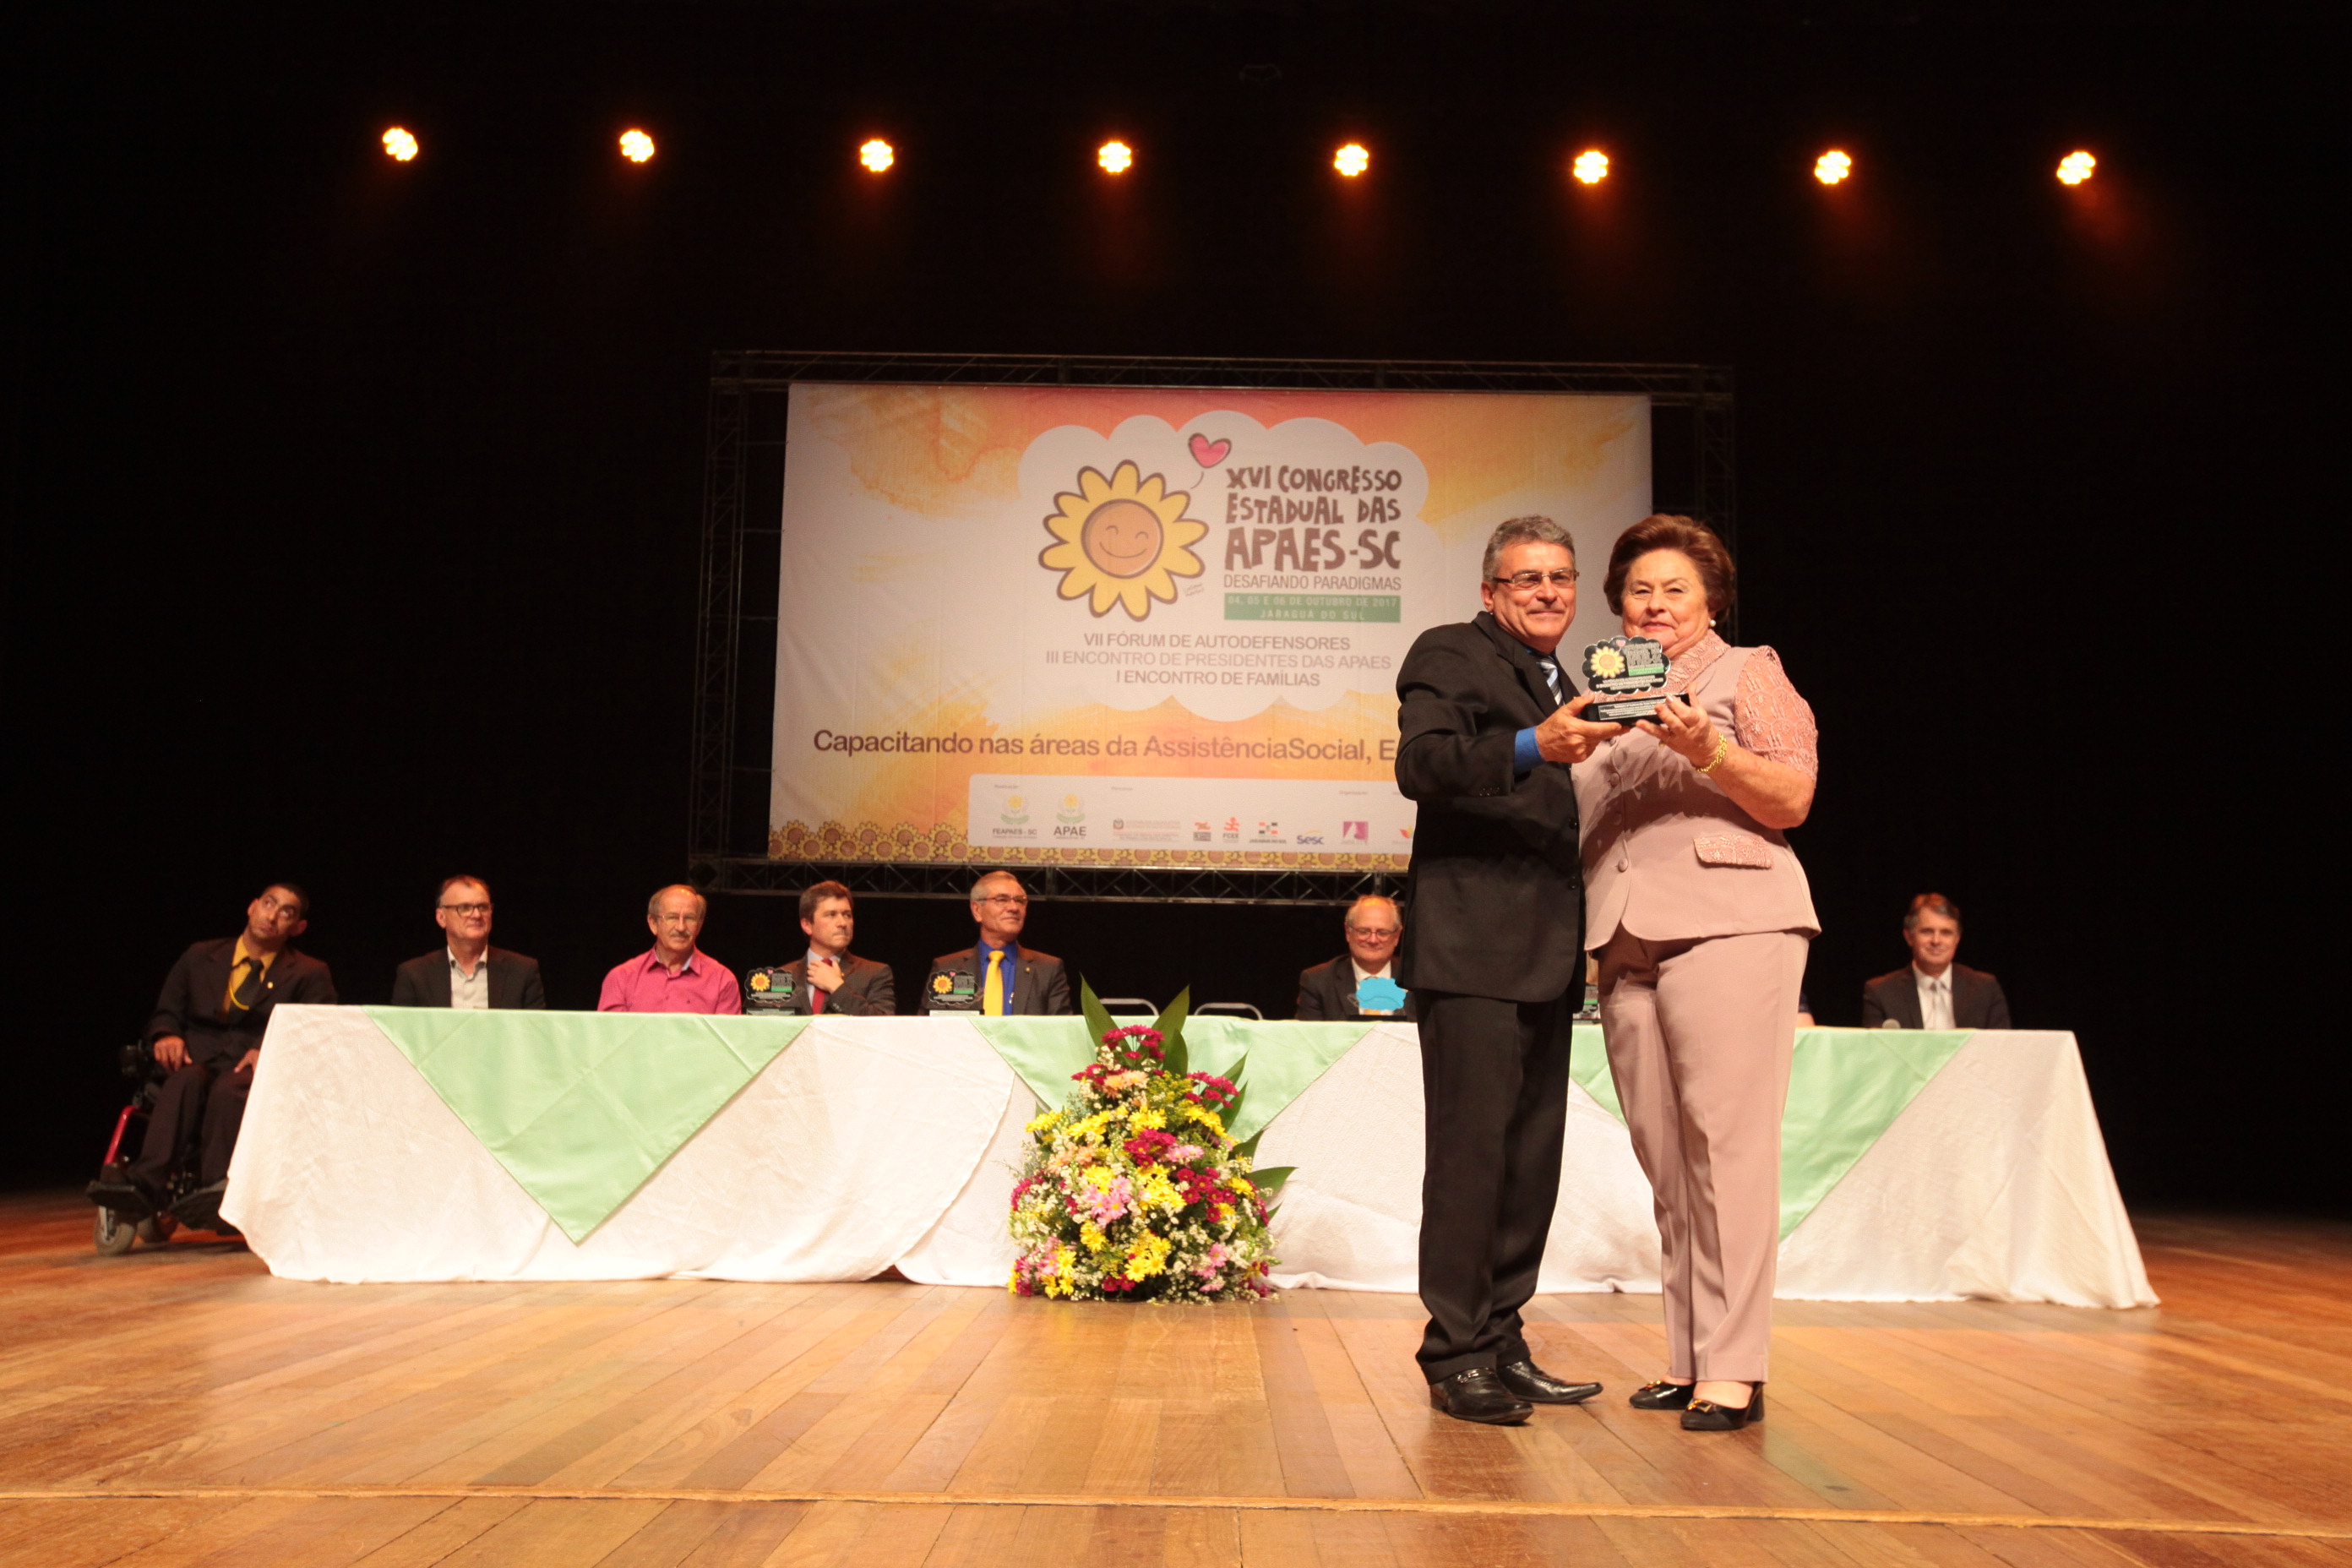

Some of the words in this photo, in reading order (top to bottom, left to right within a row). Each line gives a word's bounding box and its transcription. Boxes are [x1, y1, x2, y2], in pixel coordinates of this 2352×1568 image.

[1227, 466, 1271, 489] XVI
[1277, 466, 1402, 494] CONGRESSO
[1225, 493, 1344, 525] ESTADUAL
[1357, 496, 1401, 524] DAS
[1225, 526, 1401, 572] APAES-SC
[1224, 574, 1309, 589] DESAFIANDO
[1314, 575, 1402, 591] PARADIGMAS
[1263, 596, 1269, 605] E
[1289, 596, 1303, 606] DE
[1306, 596, 1352, 607] OUTUBRO
[1356, 597, 1369, 607] DE
[1372, 598, 1397, 607] 2017
[1320, 610, 1337, 619] DO
[1342, 610, 1365, 621] SUL
[1084, 634, 1103, 646] VII
[1108, 631, 1166, 647] FÓRUM
[1169, 634, 1191, 648] DE
[1195, 635, 1351, 651] AUTODEFENSORES
[1046, 651, 1059, 664] III
[1063, 651, 1156, 666] ENCONTRO
[1160, 653, 1182, 666] DE
[1185, 654, 1298, 667] PRESIDENTES
[1302, 655, 1335, 668] DAS
[1338, 656, 1392, 670] APAES
[1124, 671, 1217, 685] ENCONTRO
[1221, 672, 1243, 685] DE
[1247, 670, 1320, 687] FAMÍLIAS
[814, 729, 973, 757] Capacitando
[979, 737, 1024, 754] nas
[1029, 733, 1100, 756] áreas
[1105, 736, 1138, 757] da
[1054, 826, 1087, 836] APAE
